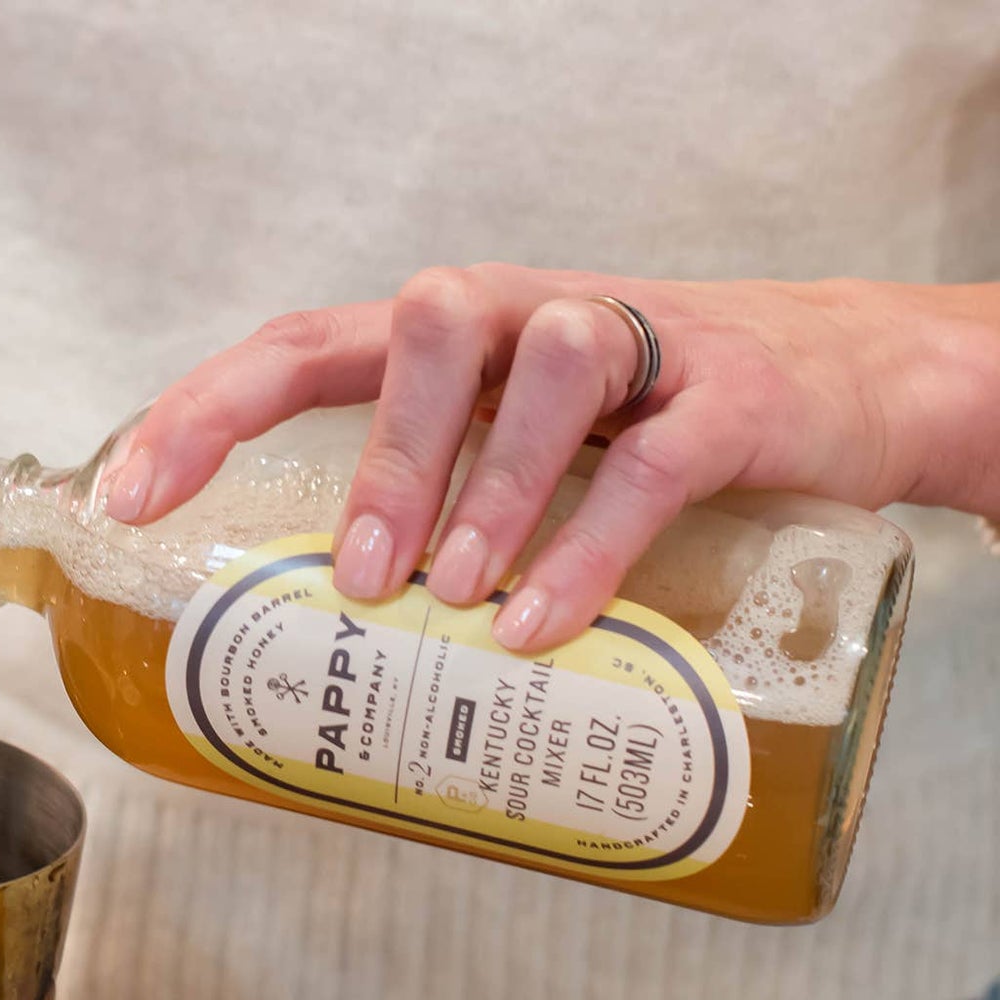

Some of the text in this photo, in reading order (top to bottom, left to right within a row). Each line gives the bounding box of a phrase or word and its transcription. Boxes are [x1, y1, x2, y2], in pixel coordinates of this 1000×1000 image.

[220, 588, 313, 769] MADE WITH BOURBON BARREL
[242, 621, 285, 737] SMOKED HONEY
[315, 611, 366, 775] PAPPY
[408, 634, 450, 796] NO. 2 NON-ALCOHOLIC
[452, 704, 469, 757] SMOKED
[479, 678, 517, 793] KENTUCKY
[506, 658, 554, 822] SOUR COCKTAIL
[541, 719, 572, 788] MIXER
[576, 657, 693, 850] HANDCRAFTED IN CHARLESTON, SC
[611, 723, 664, 821] (503ML)
[576, 789, 604, 812] 17
